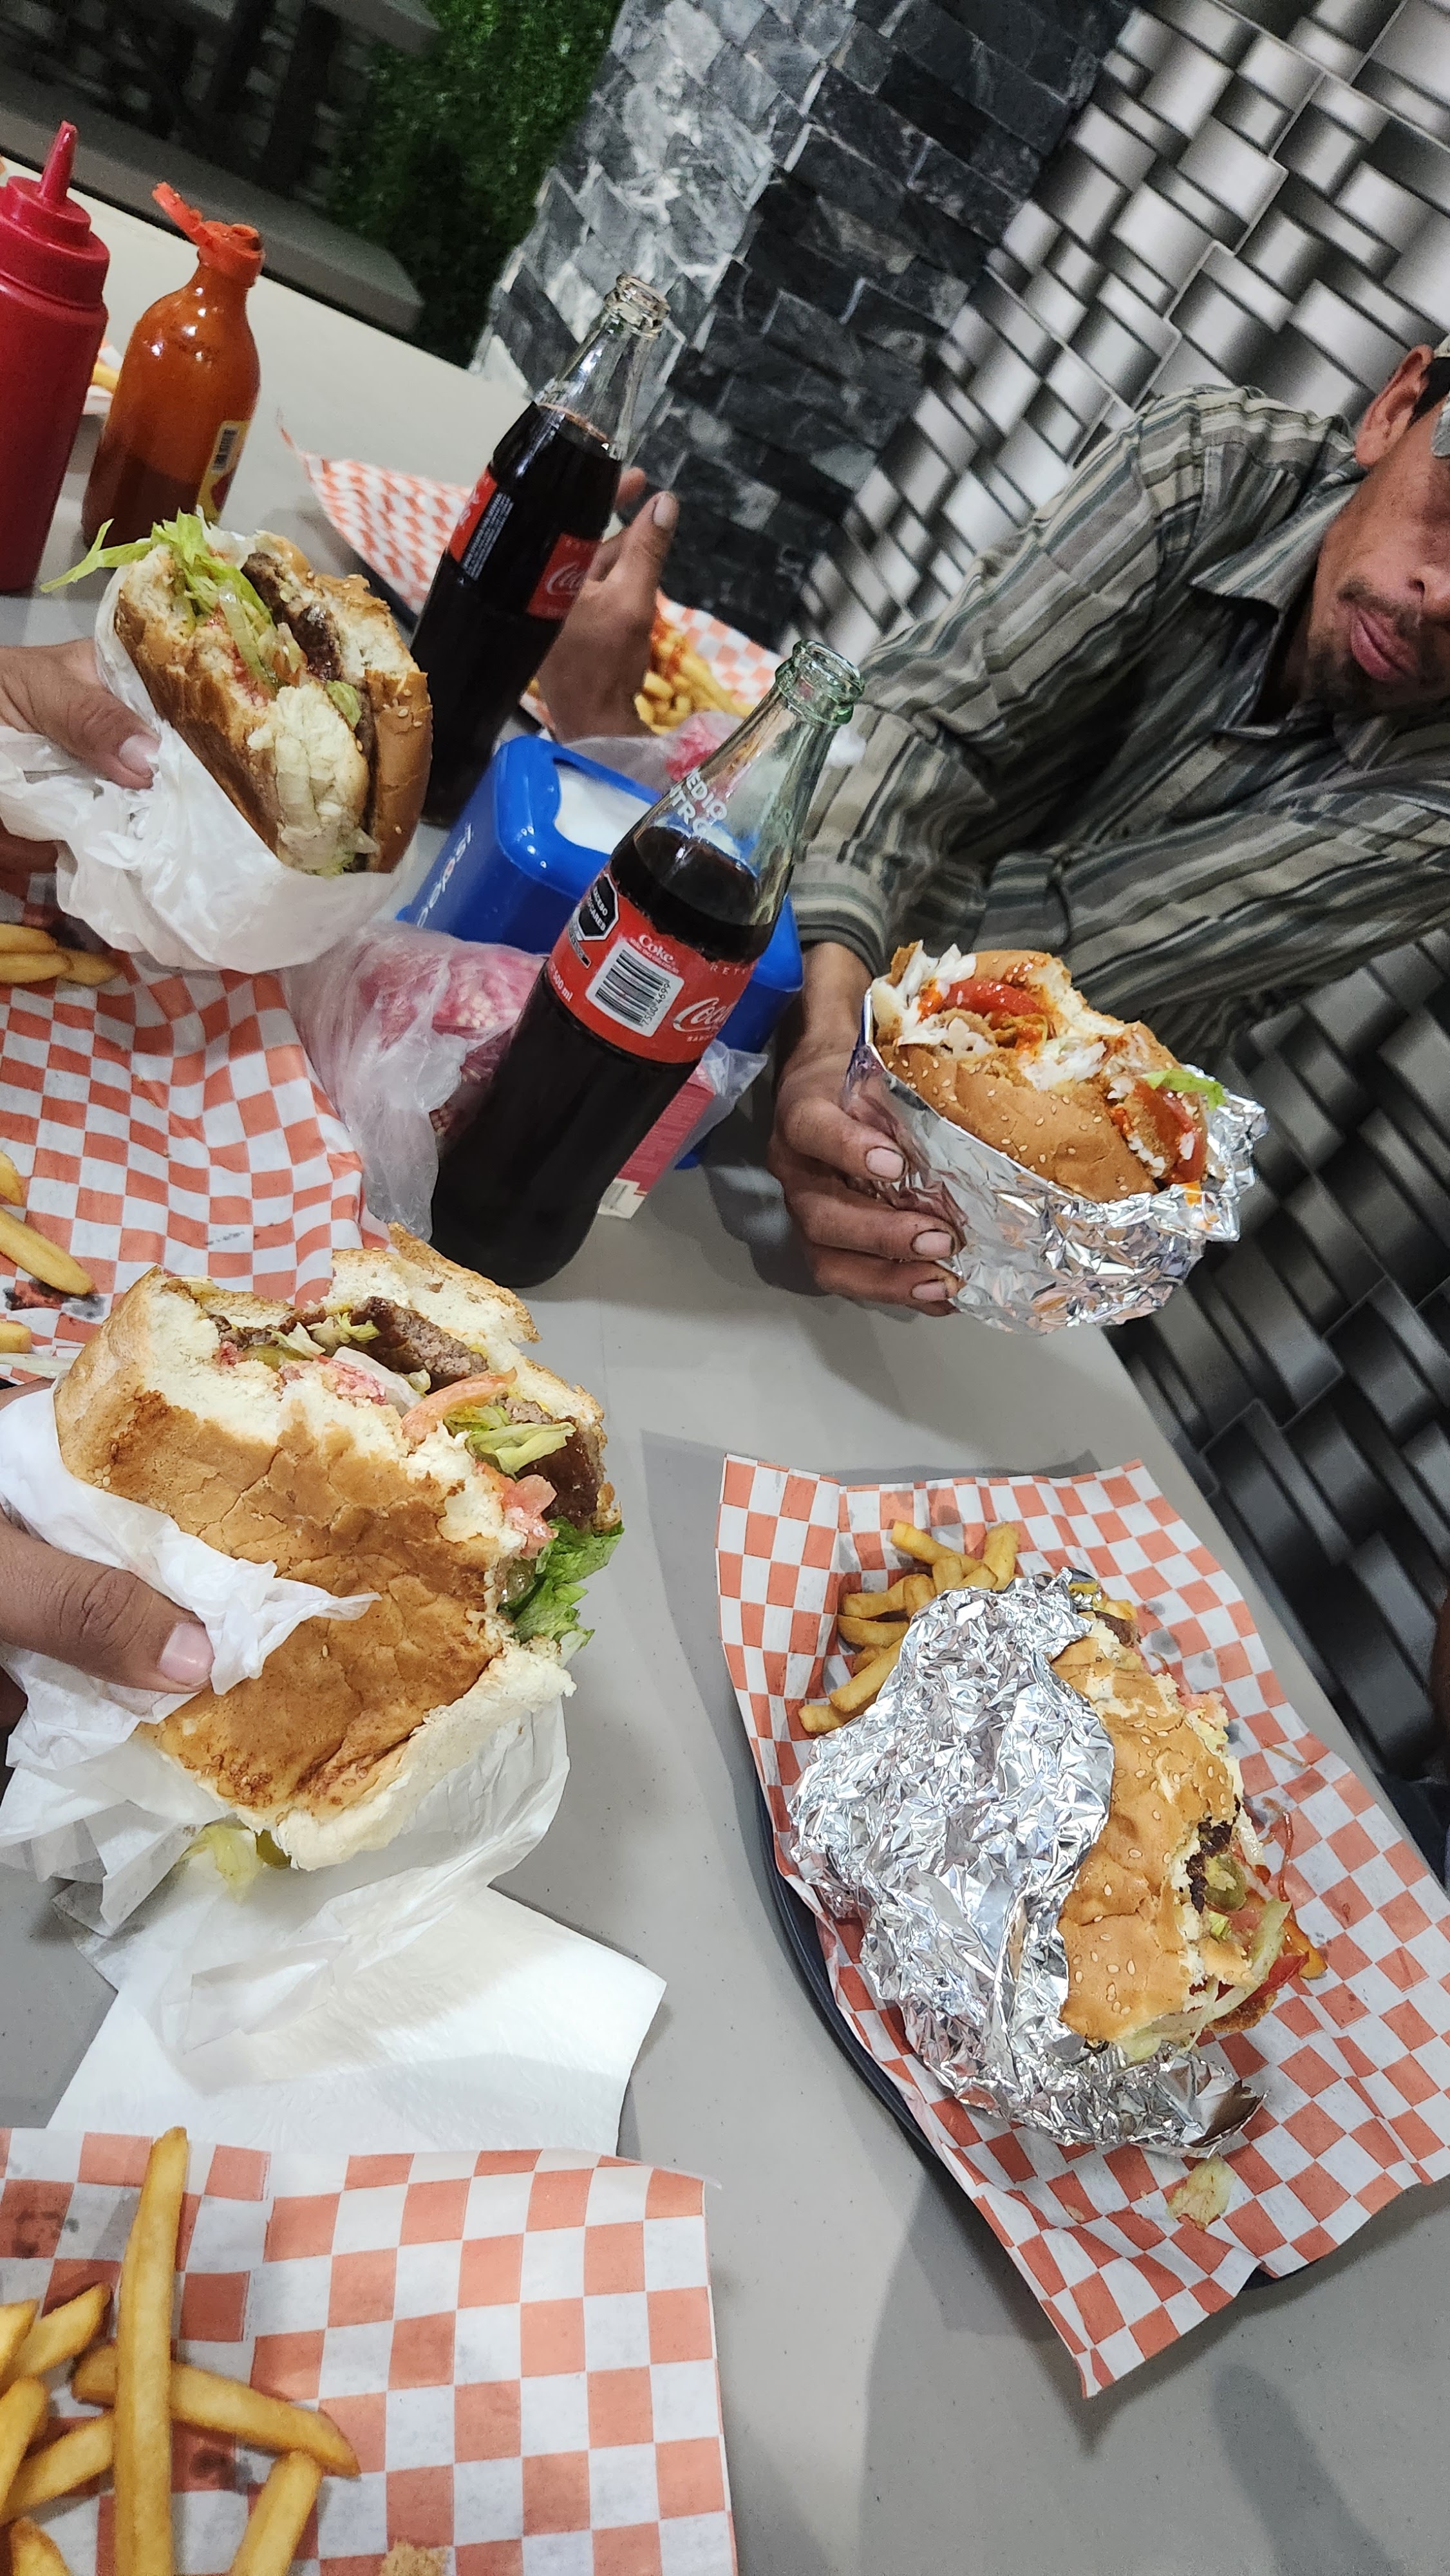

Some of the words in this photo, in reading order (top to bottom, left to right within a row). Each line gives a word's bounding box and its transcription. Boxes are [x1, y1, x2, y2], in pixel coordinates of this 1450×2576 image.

[639, 934, 674, 963] Coke
[561, 987, 573, 1002] ml
[655, 983, 671, 1005] 4699
